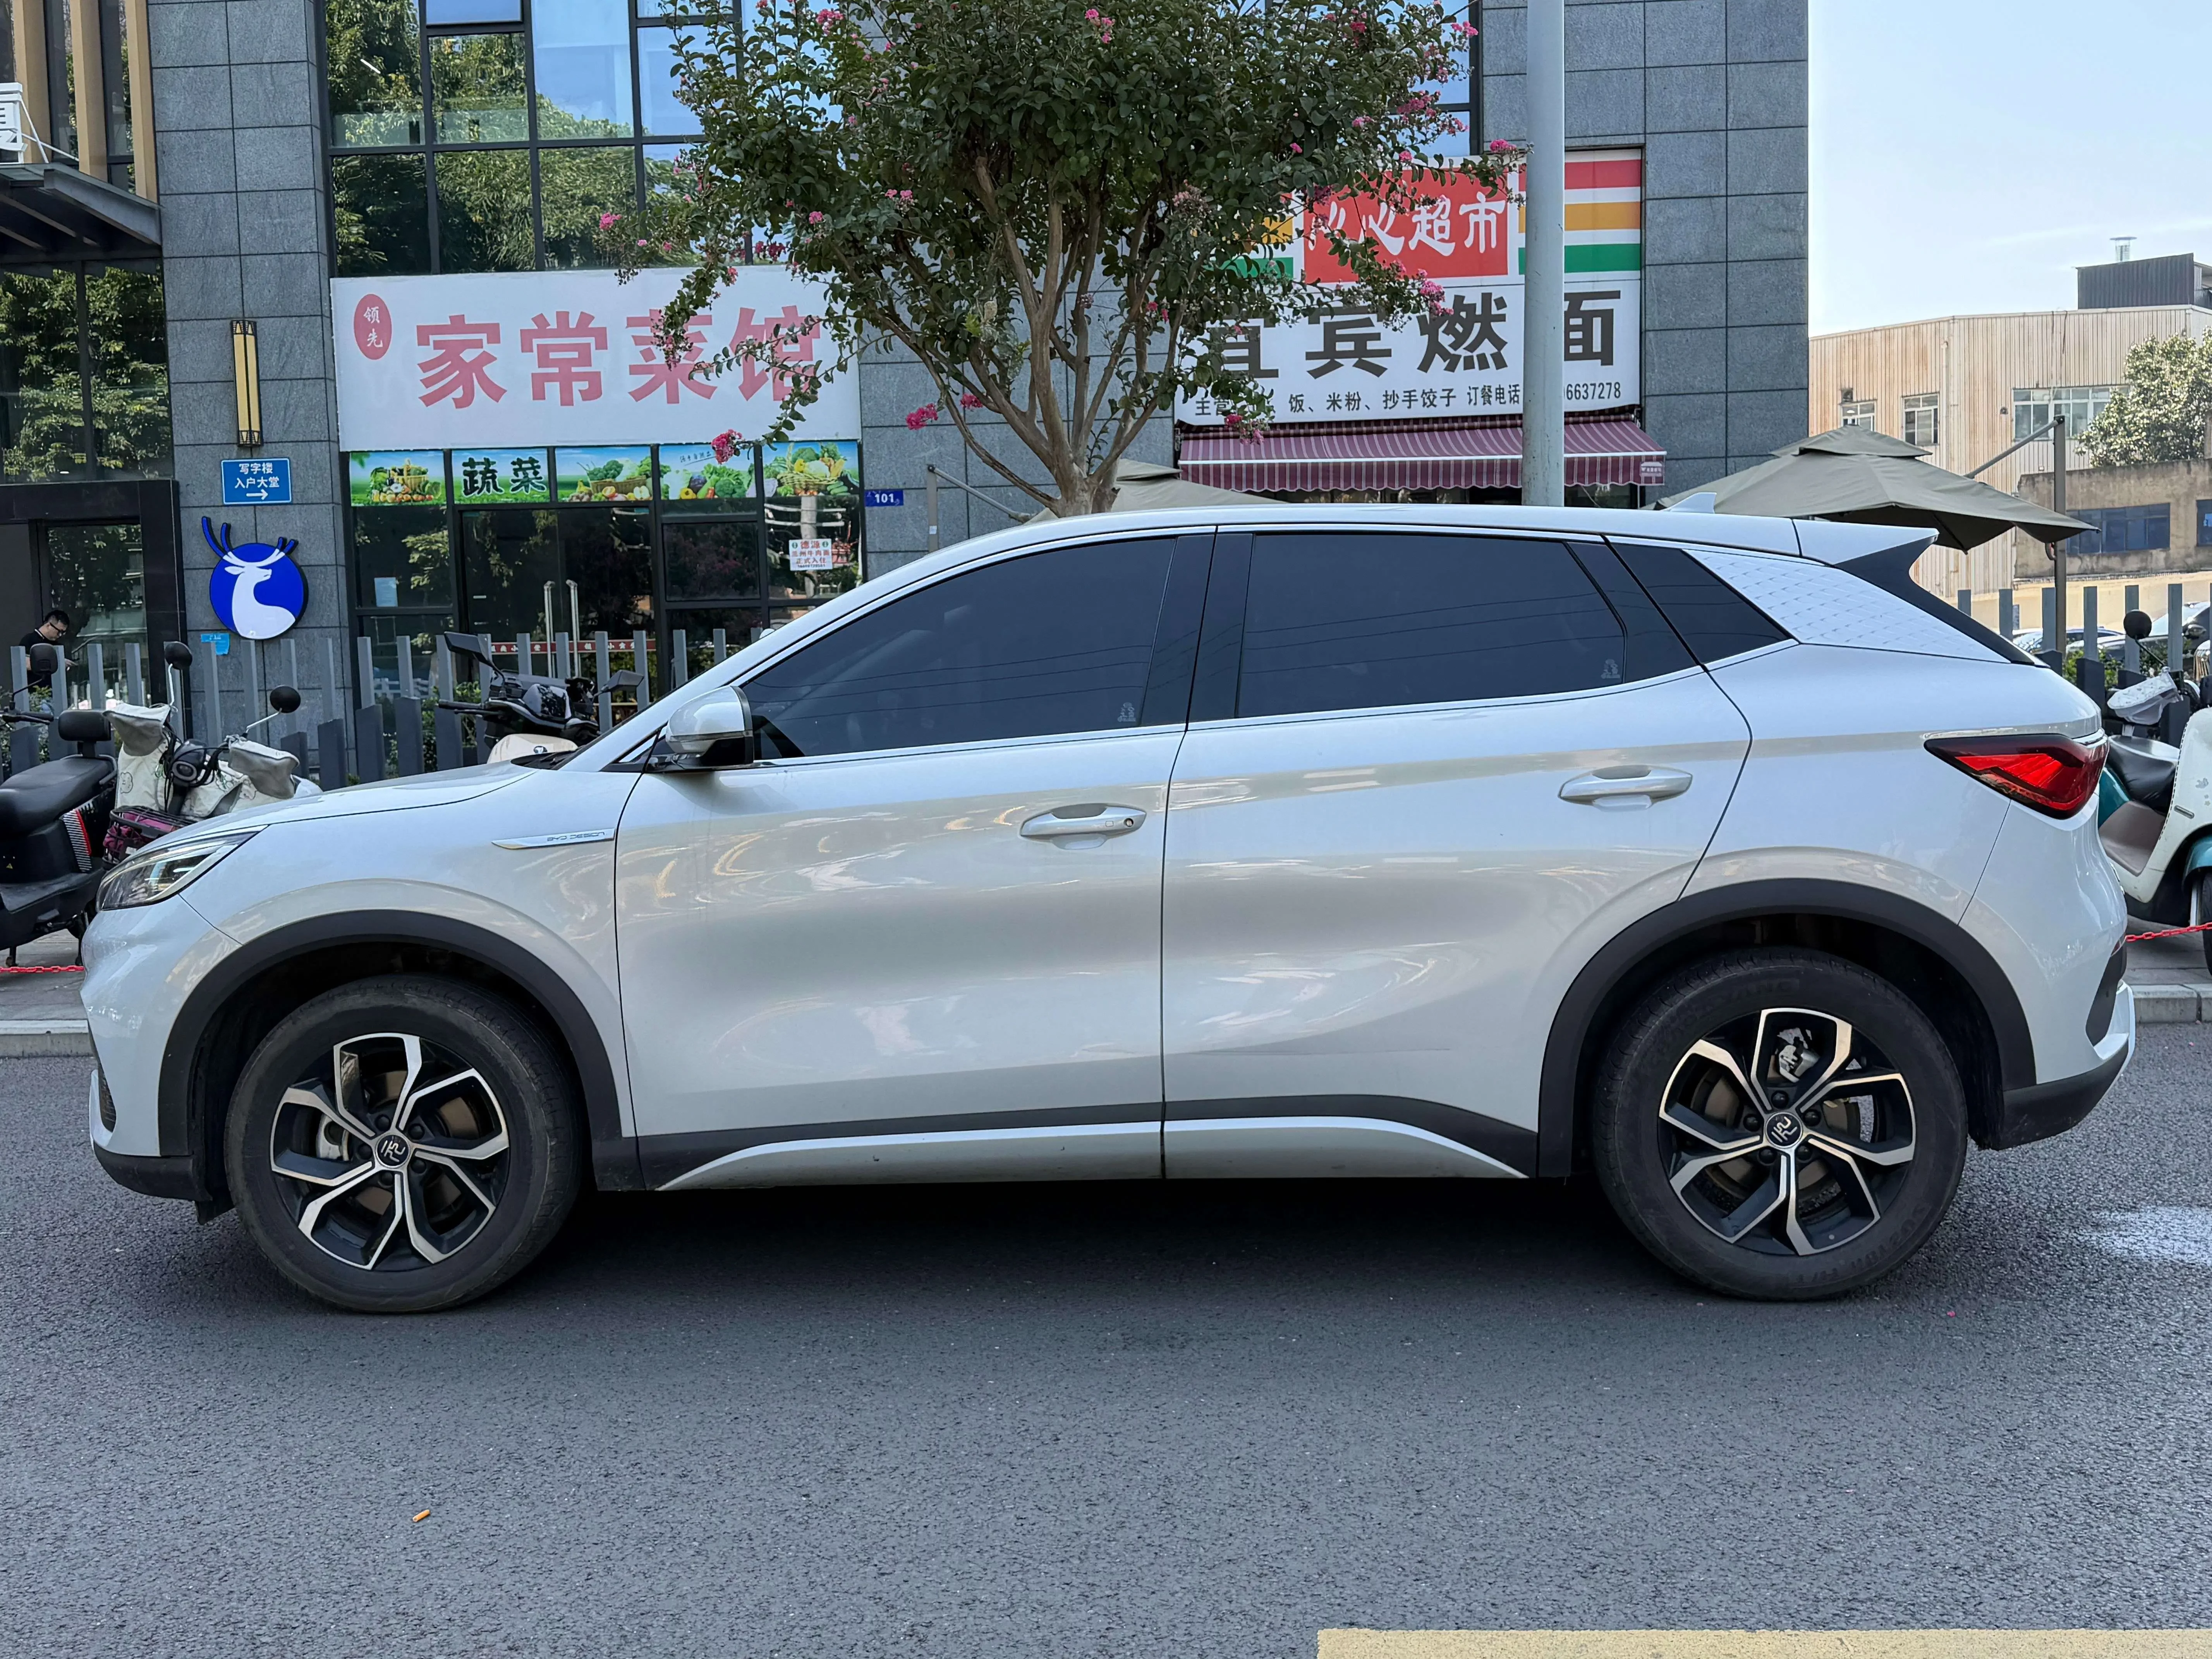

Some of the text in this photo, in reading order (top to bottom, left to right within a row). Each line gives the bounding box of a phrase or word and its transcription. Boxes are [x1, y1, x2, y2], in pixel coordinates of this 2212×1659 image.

[363, 306, 383, 348] 领先
[416, 305, 821, 409] 家常菜馆
[1467, 384, 1521, 406] 订餐电话
[1563, 381, 1621, 400] 6637278
[239, 462, 273, 475] 写字楼
[462, 457, 546, 496] 蔬菜
[234, 476, 280, 489] 入户大堂
[874, 493, 894, 503] 101
